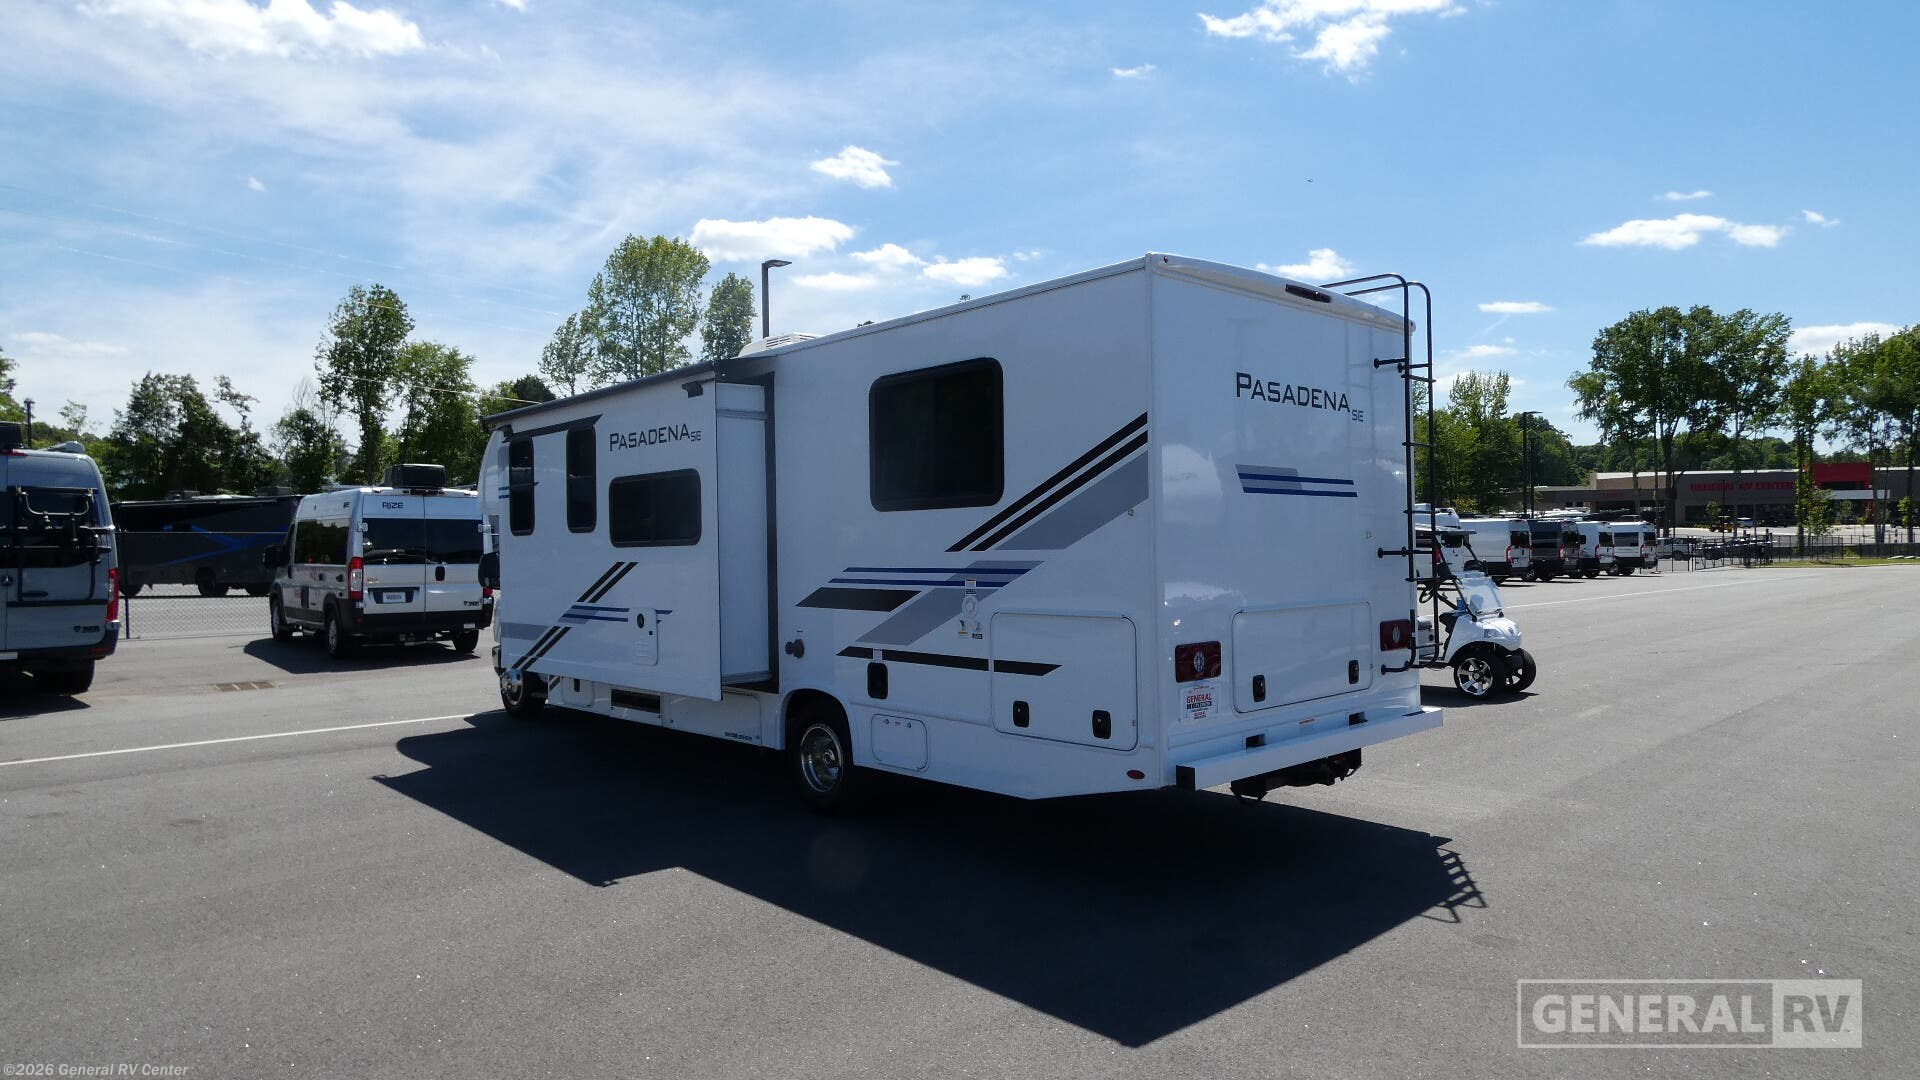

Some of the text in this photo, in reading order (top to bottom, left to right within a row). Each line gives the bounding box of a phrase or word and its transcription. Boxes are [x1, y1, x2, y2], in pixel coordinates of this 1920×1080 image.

[1236, 371, 1364, 423] PASADENA SE
[609, 423, 702, 452] PASADENA SE
[382, 501, 404, 510] RIZE
[1186, 692, 1213, 704] GENERAL
